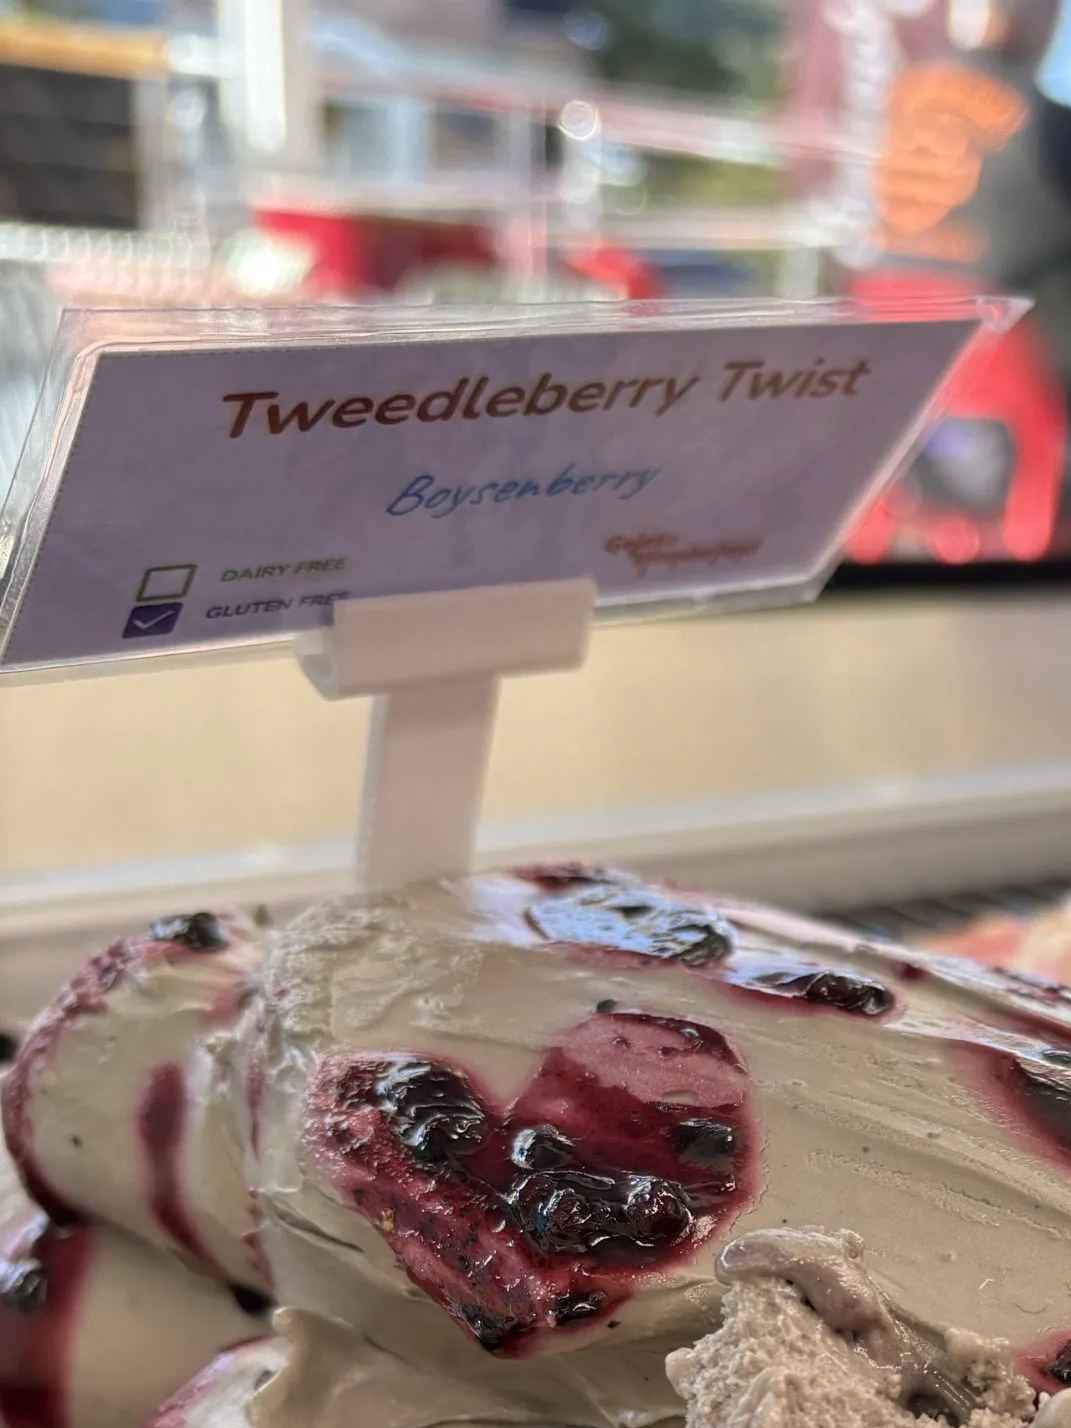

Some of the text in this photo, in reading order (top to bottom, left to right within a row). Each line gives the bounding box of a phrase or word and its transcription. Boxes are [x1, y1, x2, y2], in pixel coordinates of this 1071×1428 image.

[223, 357, 872, 438] Tweedleberry Twist
[386, 463, 661, 519] Boysenberry
[220, 557, 348, 582] DAIRY FREE
[205, 599, 294, 619] GLUTEN
